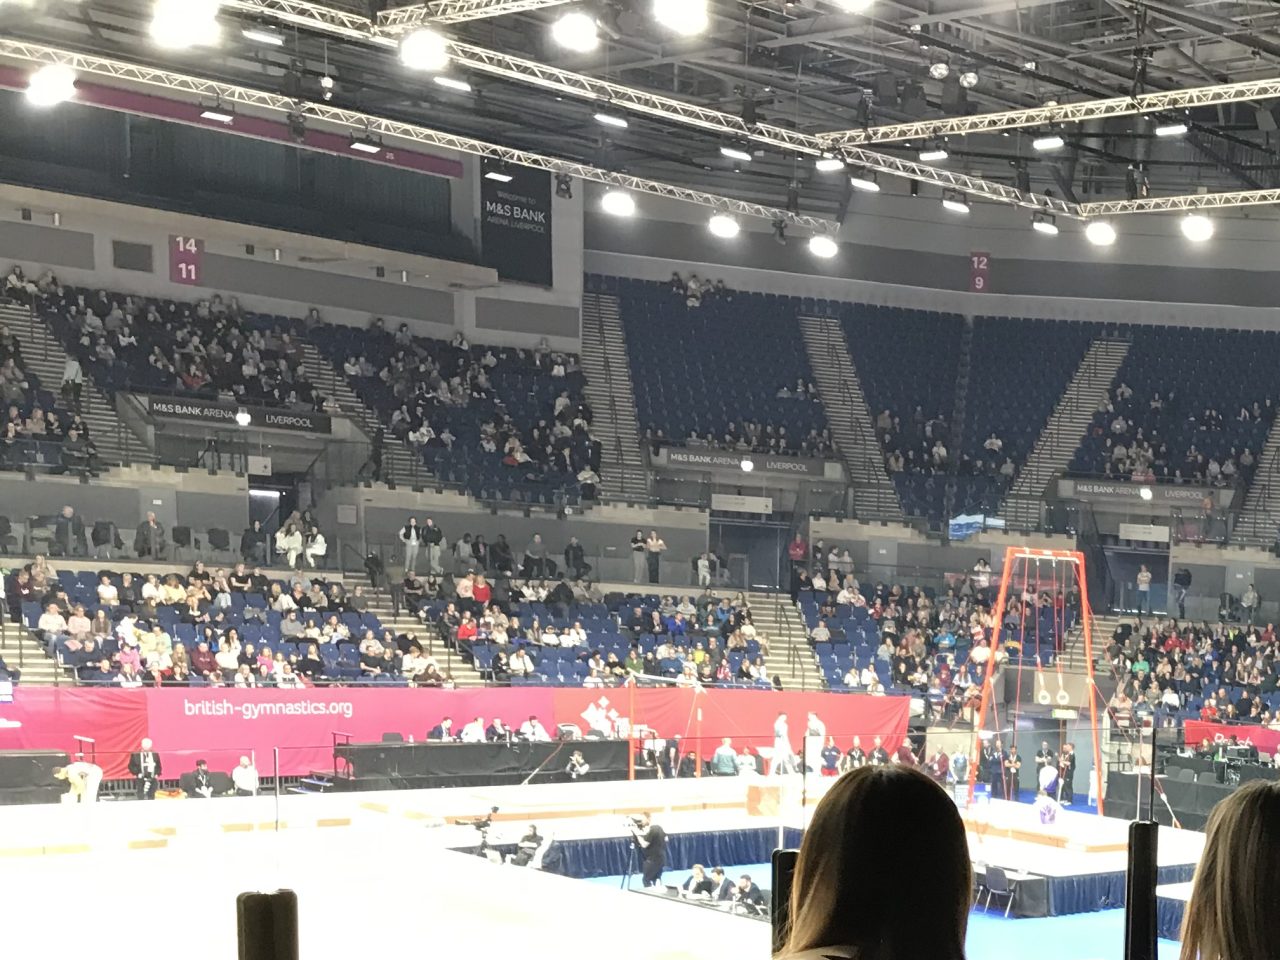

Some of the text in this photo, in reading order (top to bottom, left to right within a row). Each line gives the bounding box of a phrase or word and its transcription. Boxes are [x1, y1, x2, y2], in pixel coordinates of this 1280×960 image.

[487, 201, 545, 223] M&S BANK
[175, 236, 197, 254] 14
[178, 262, 196, 280] 11
[971, 256, 988, 269] 12
[975, 276, 984, 289] 9
[153, 402, 313, 427] M&S BANK ARENA LIVERPOOL
[670, 453, 809, 473] M&S BANK ARENA LIVERPOOL
[1077, 484, 1093, 493] M&S
[1093, 485, 1115, 494] BANK
[1164, 490, 1205, 500] LIVERPOOL
[183, 698, 354, 720] british-gymnastics.org
